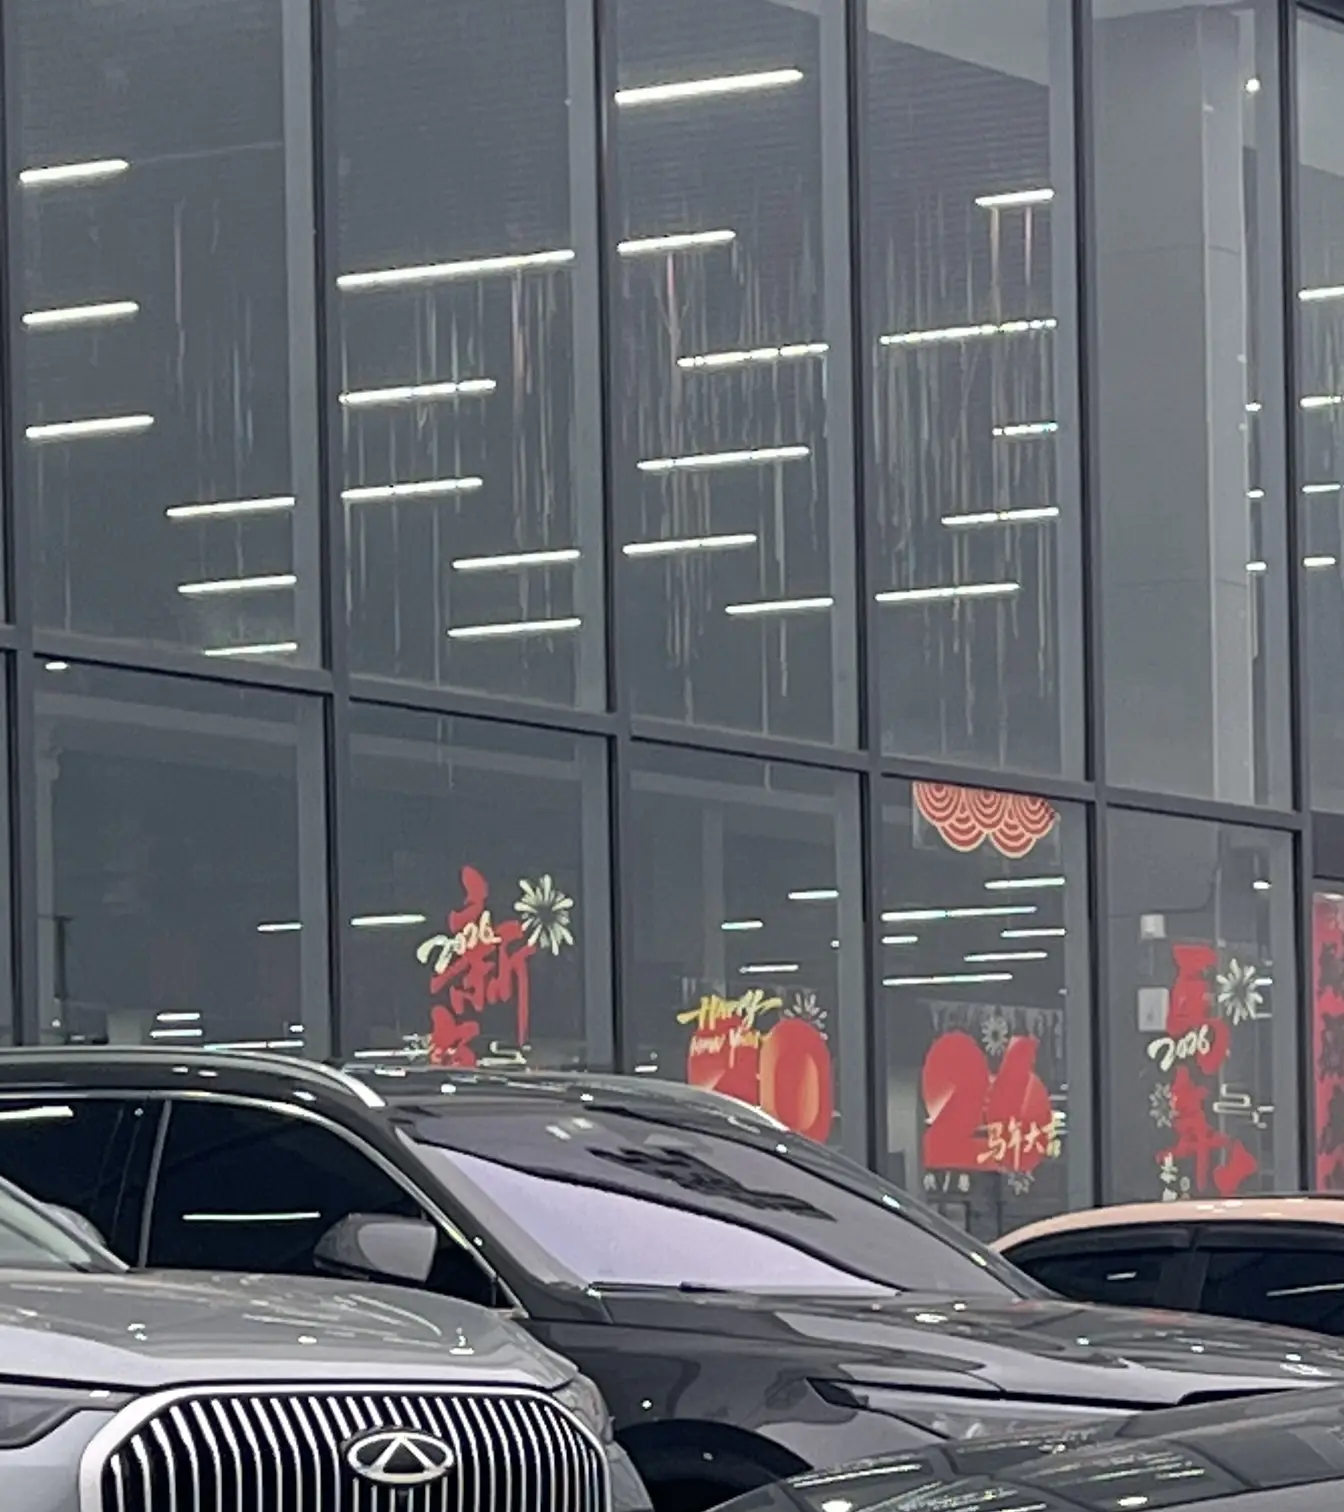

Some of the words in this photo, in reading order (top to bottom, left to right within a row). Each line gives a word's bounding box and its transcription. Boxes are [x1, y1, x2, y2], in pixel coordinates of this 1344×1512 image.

[417, 910, 503, 974] 2026
[977, 1111, 1068, 1173] 马年大吉
